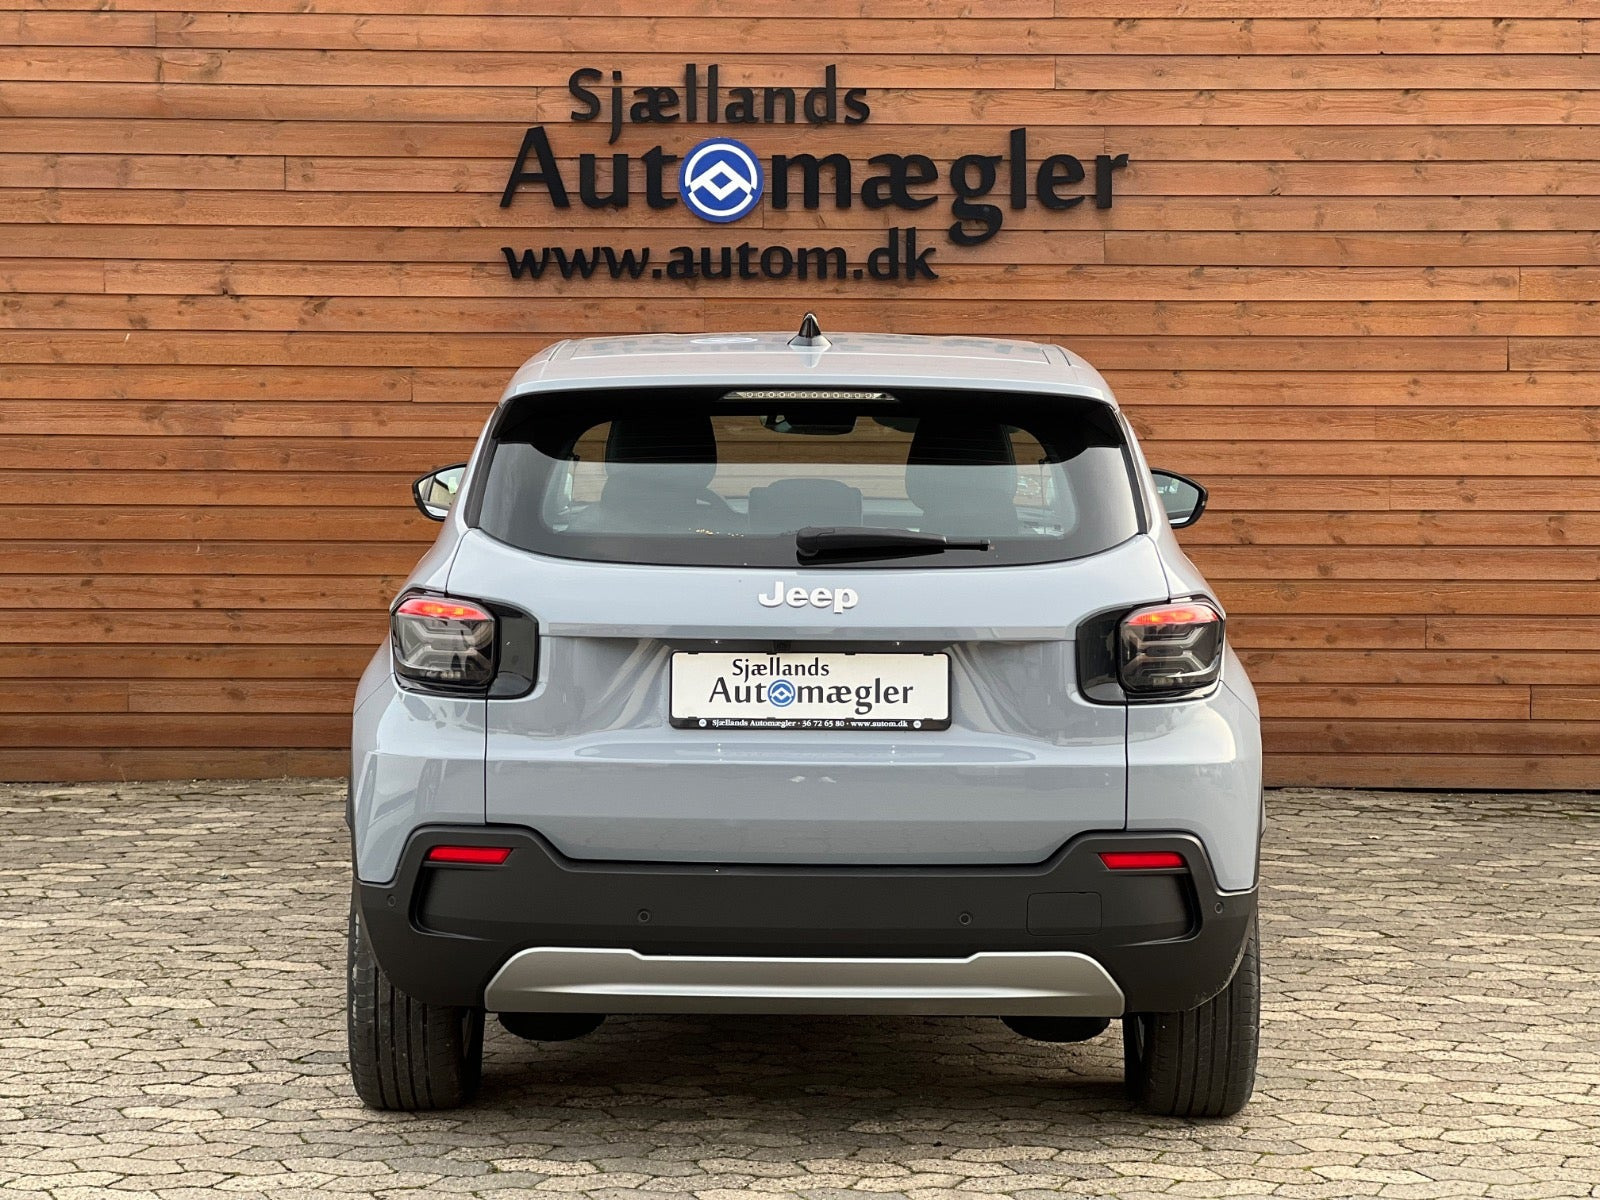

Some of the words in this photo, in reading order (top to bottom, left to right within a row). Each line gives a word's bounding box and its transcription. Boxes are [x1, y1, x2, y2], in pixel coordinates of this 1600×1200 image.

[568, 63, 871, 143] Sjællands
[500, 226, 938, 280] www.autom.dk
[758, 581, 859, 614] Jeep
[732, 656, 830, 682] Sjællands
[712, 718, 748, 728] Sjællands
[750, 719, 796, 729] Automægler
[801, 719, 812, 728] 36
[813, 719, 823, 728] 72
[824, 719, 834, 728] 65
[835, 719, 845, 728] 80
[849, 719, 908, 729] www.autom.dk
